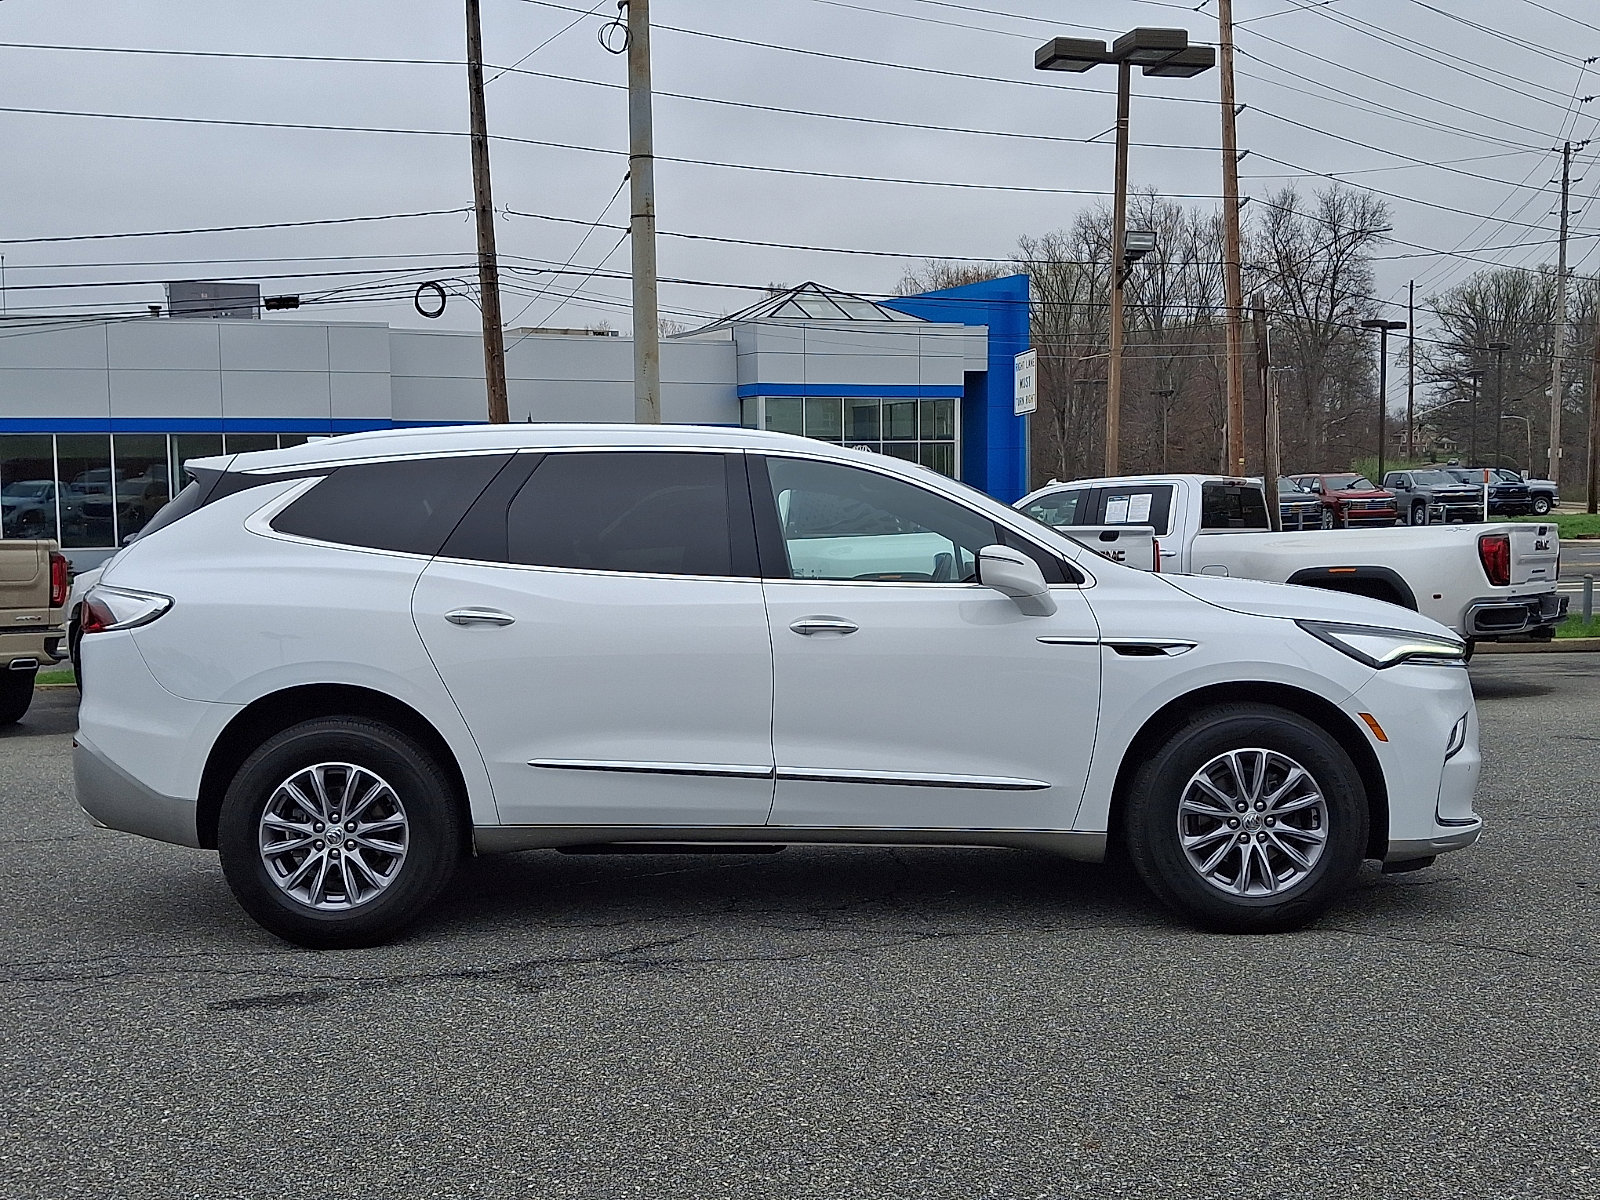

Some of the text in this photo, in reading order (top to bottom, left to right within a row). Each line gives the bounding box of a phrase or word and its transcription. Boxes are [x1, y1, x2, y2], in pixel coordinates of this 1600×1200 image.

[1016, 358, 1035, 372] RIGHT LANE
[1020, 376, 1031, 389] MUST
[1016, 394, 1035, 407] TURN RIGHT
